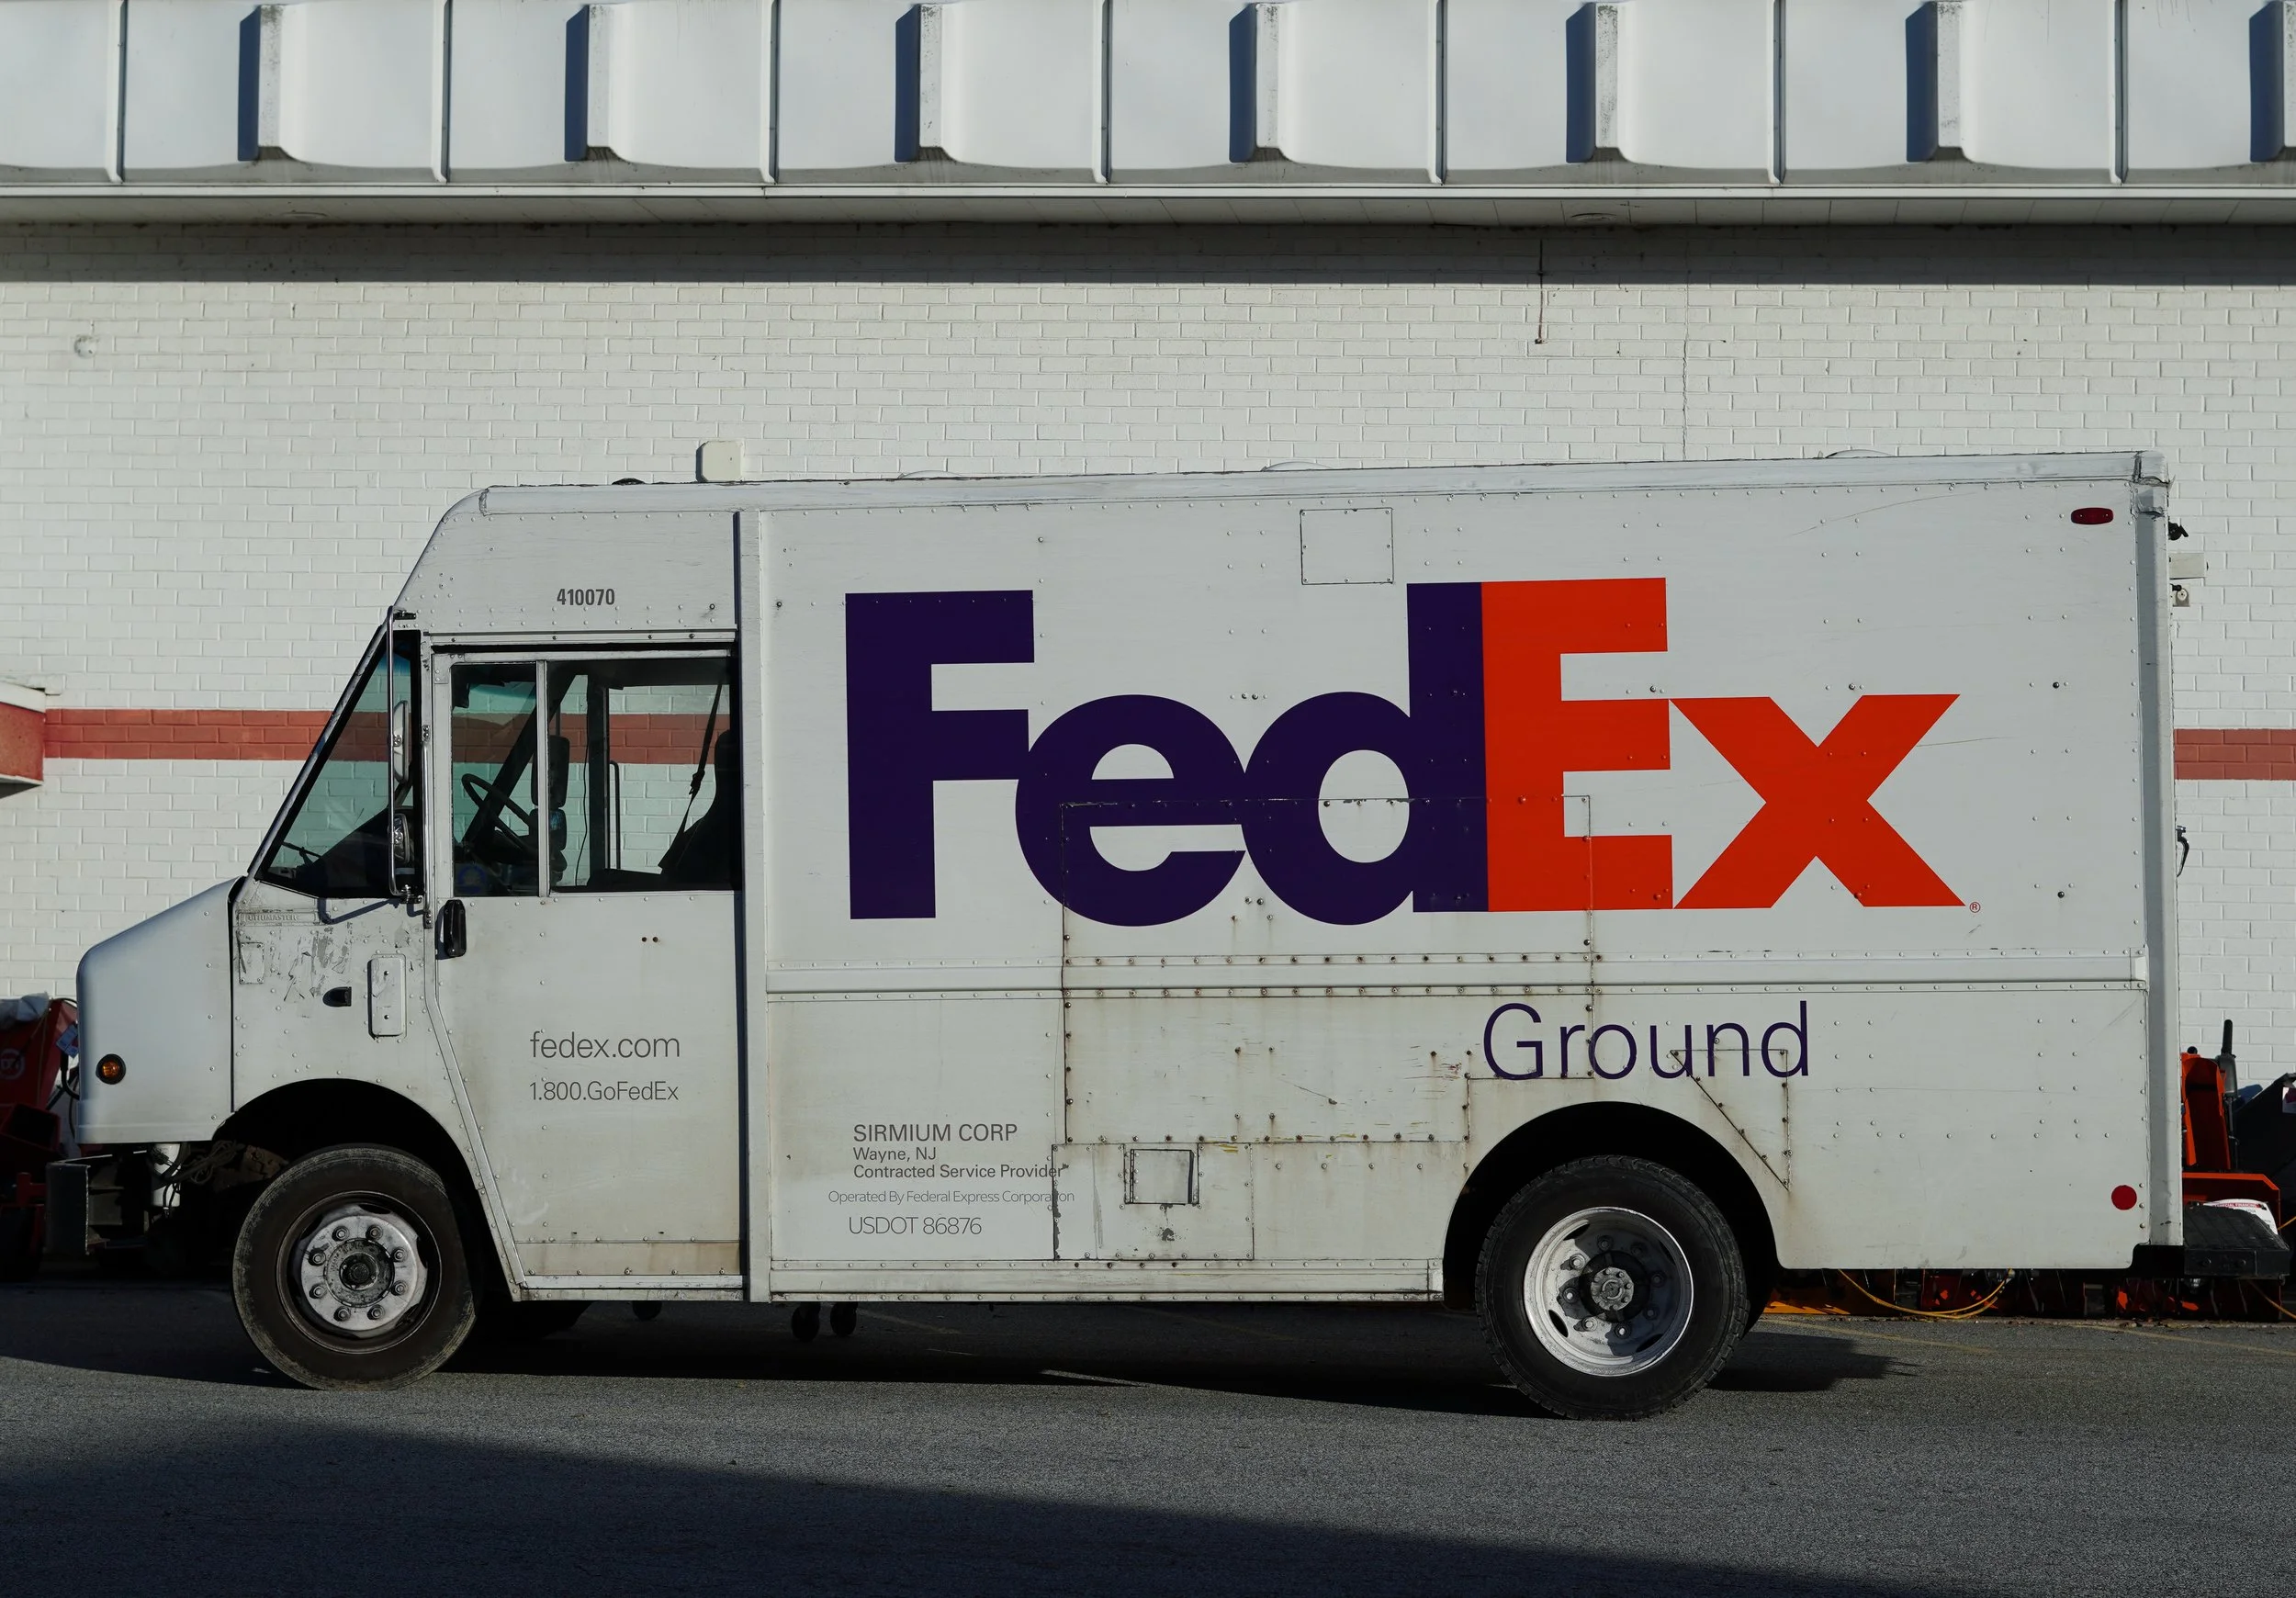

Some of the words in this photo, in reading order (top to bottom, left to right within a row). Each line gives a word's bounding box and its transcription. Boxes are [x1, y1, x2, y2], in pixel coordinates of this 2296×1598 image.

[556, 588, 616, 606] 410070
[846, 577, 1966, 927] FedEx
[530, 1030, 681, 1058] fedex.com
[1483, 1000, 1809, 1081] Ground
[529, 1080, 679, 1101] 1.800.GoFedEx
[853, 1123, 951, 1142] SIRMIUM
[959, 1123, 1018, 1142] CORP
[853, 1146, 910, 1164] Wayne,
[916, 1146, 937, 1161] NJ
[853, 1164, 935, 1178] Contracted
[940, 1164, 996, 1178] Service
[1000, 1164, 1065, 1178] Provider
[827, 1190, 886, 1206] Operated
[888, 1191, 906, 1206] By
[906, 1190, 951, 1203] Federal
[953, 1190, 1000, 1206] Express
[1002, 1190, 1075, 1206] Corporaon
[849, 1216, 919, 1234] USDOT
[923, 1216, 983, 1235] 86876
